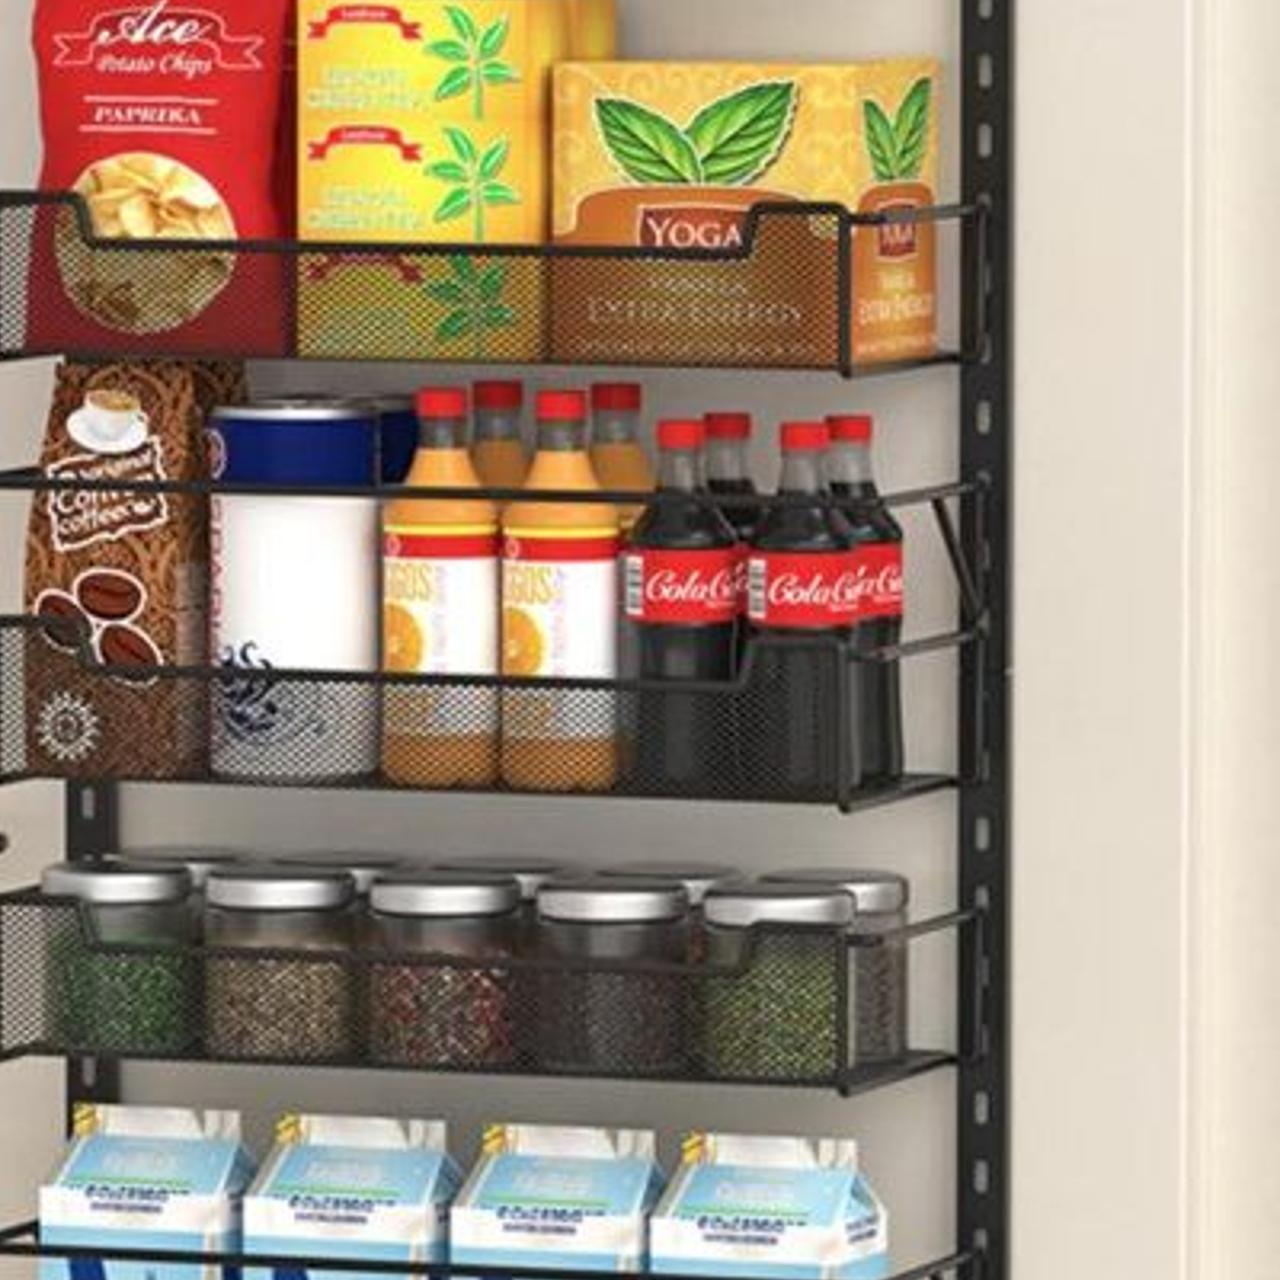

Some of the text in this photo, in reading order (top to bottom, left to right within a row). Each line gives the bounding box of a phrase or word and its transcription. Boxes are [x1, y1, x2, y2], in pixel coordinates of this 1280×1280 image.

[96, 52, 212, 80] Potato Chips
[94, 106, 202, 126] PAPRIKA
[647, 217, 743, 248] YOGA
